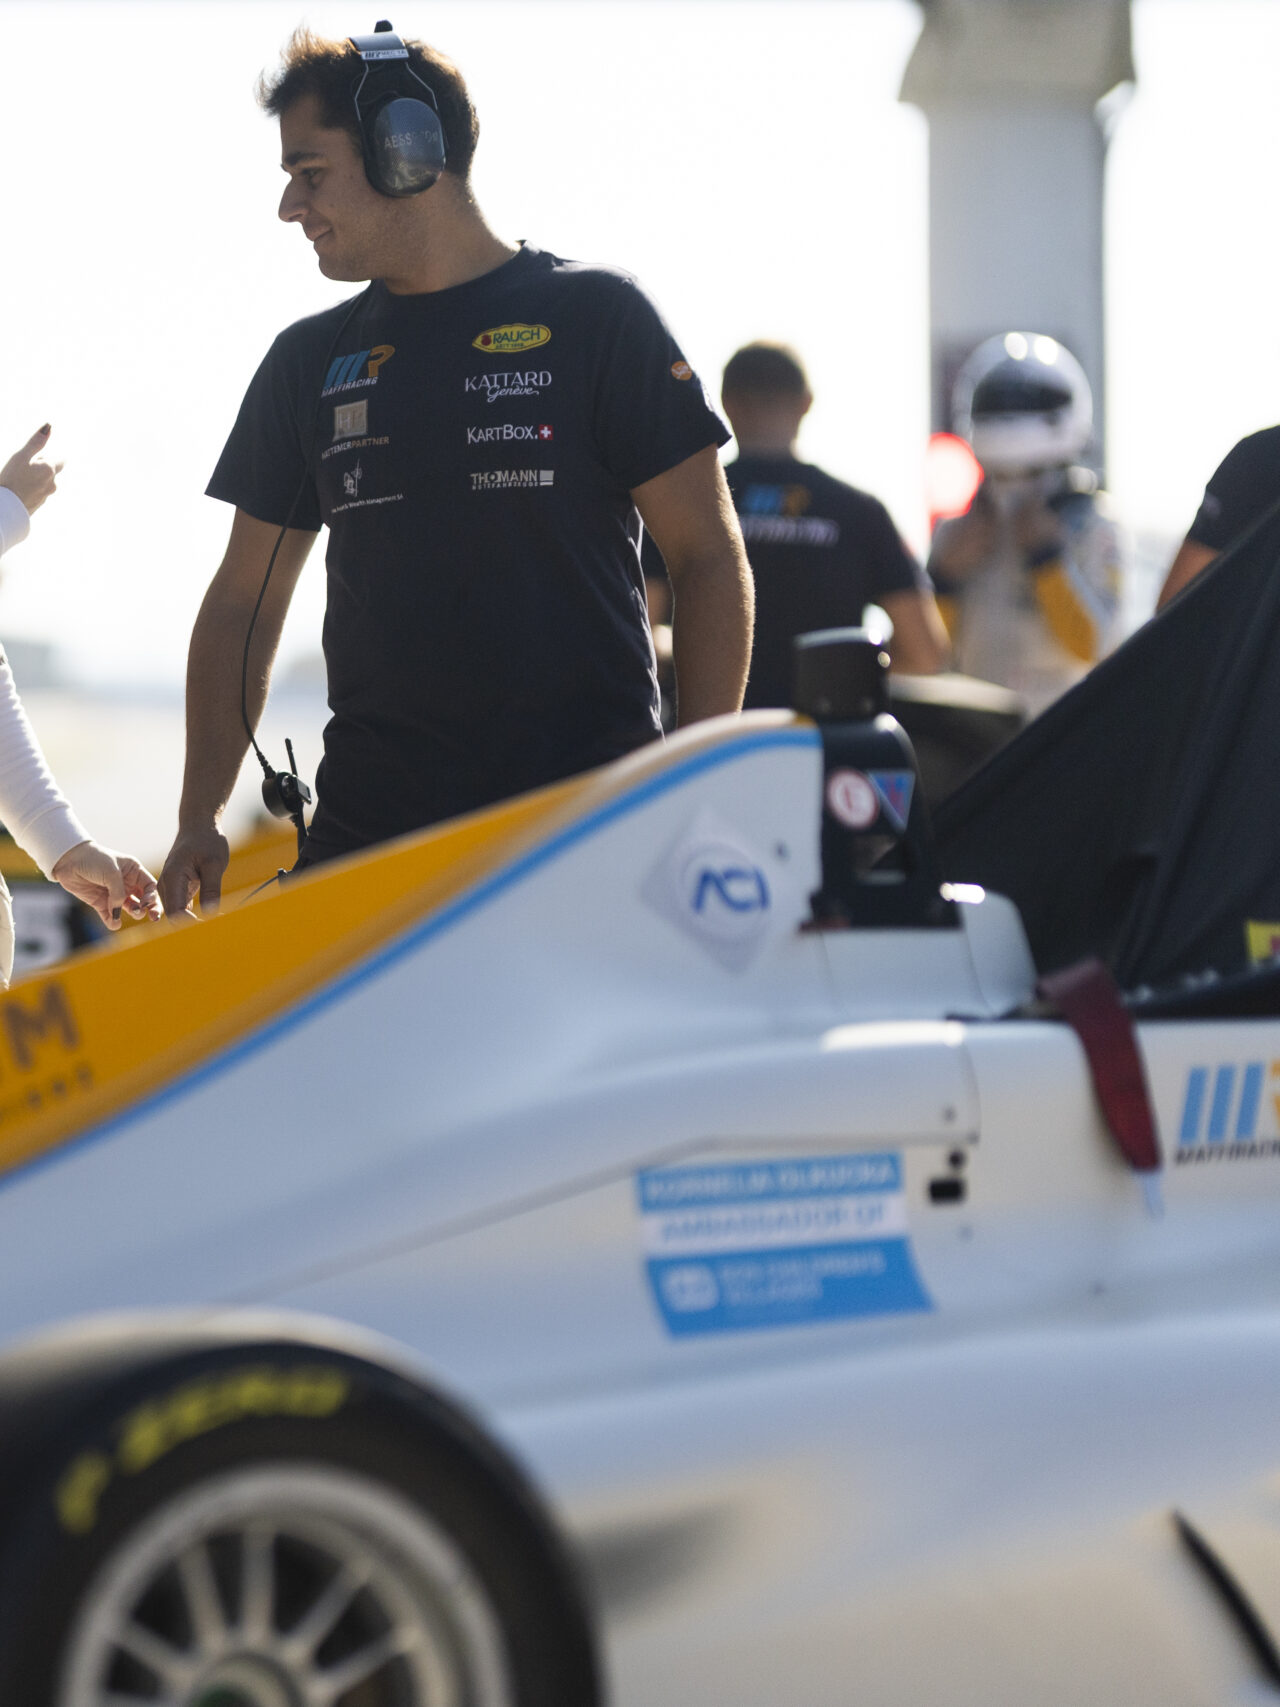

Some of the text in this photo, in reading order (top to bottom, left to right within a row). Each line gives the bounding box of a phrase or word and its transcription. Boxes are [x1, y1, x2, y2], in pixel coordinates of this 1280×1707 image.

[493, 328, 540, 344] RAUCH
[321, 377, 378, 398] MAFFIRACING
[465, 371, 552, 392] KATTARD
[487, 385, 539, 402] Genève
[470, 470, 538, 484] THOMANN
[692, 866, 771, 915] ACI
